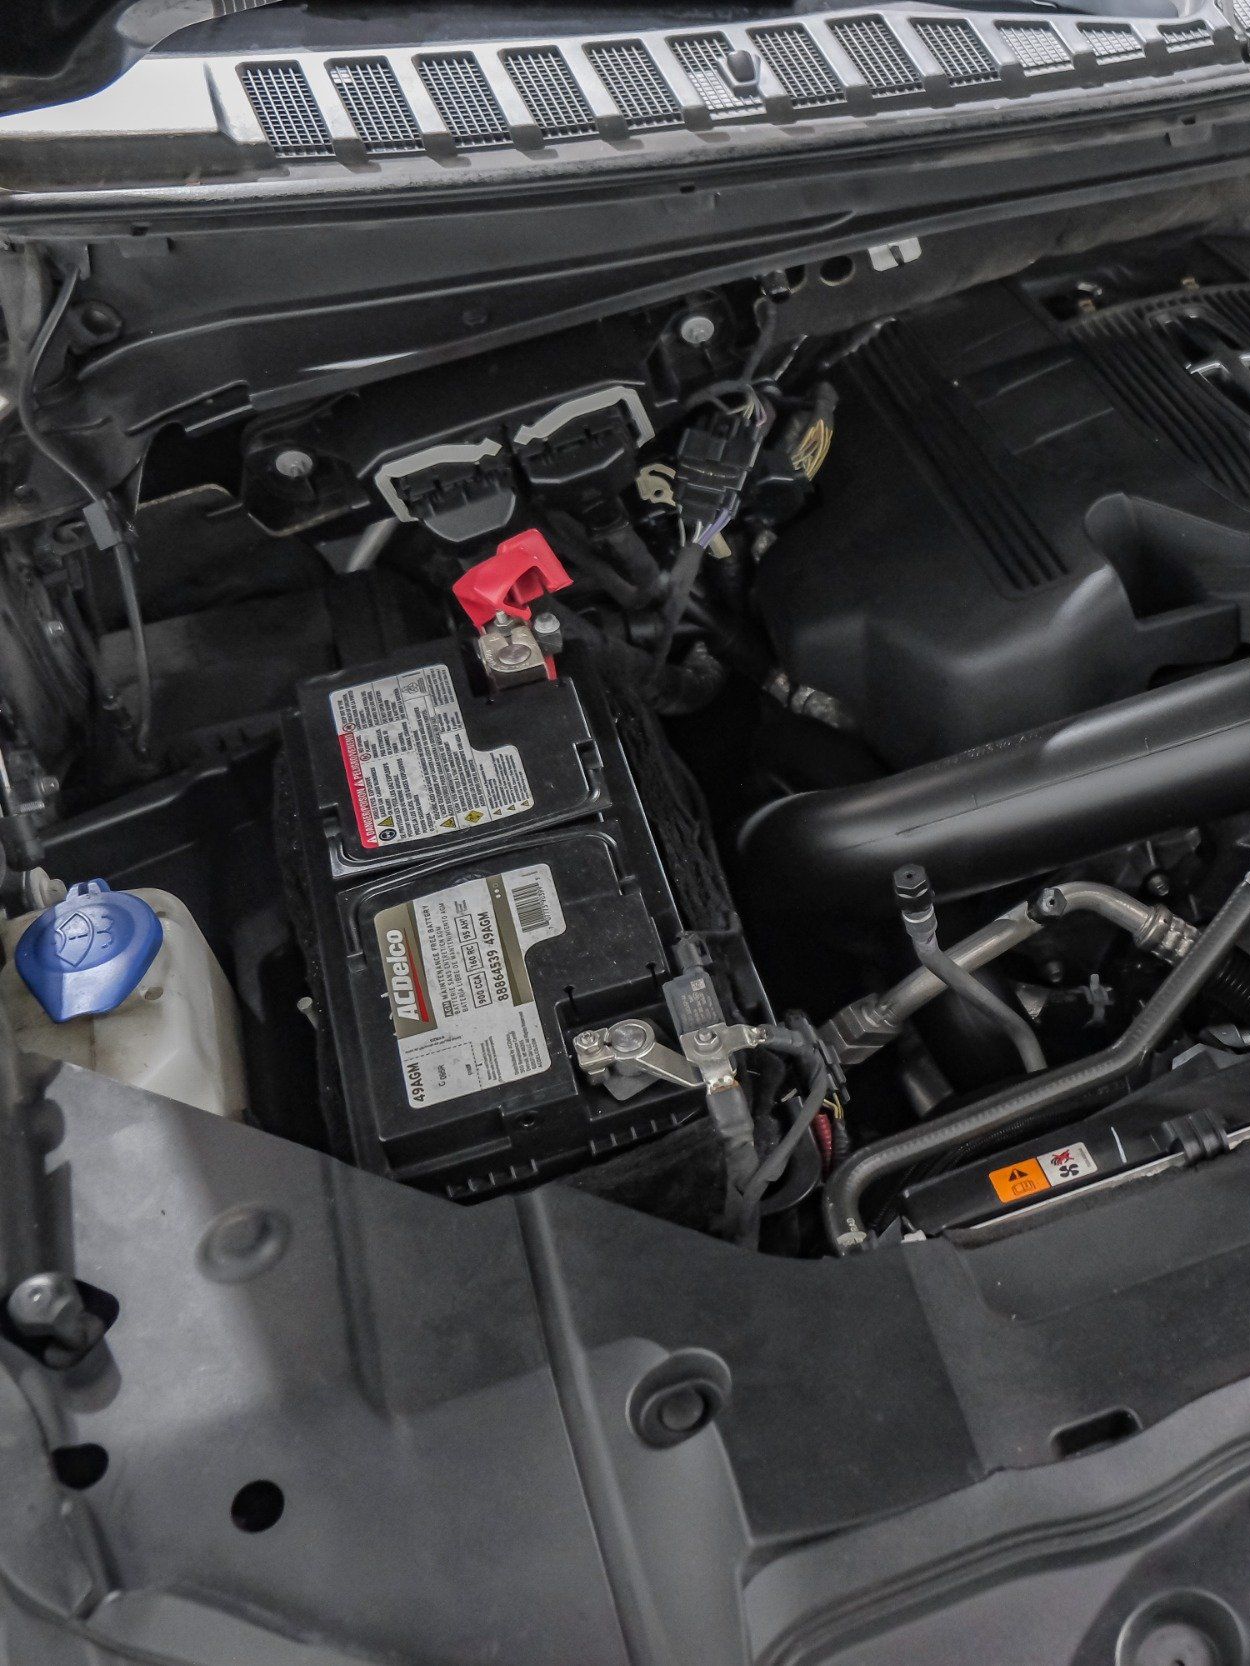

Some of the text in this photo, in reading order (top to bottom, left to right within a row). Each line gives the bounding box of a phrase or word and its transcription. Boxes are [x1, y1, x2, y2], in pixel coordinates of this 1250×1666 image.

[421, 904, 434, 933] BATTERY
[428, 934, 438, 951] FREE
[462, 930, 471, 939] 95
[466, 945, 477, 968] 160 RC
[476, 910, 509, 1001] 88864539 49AGM
[385, 928, 419, 1020] ACDelco
[431, 952, 448, 999] MAINTENANCE
[472, 974, 486, 1004] 900 CCA
[406, 1062, 425, 1103] 49AGM
